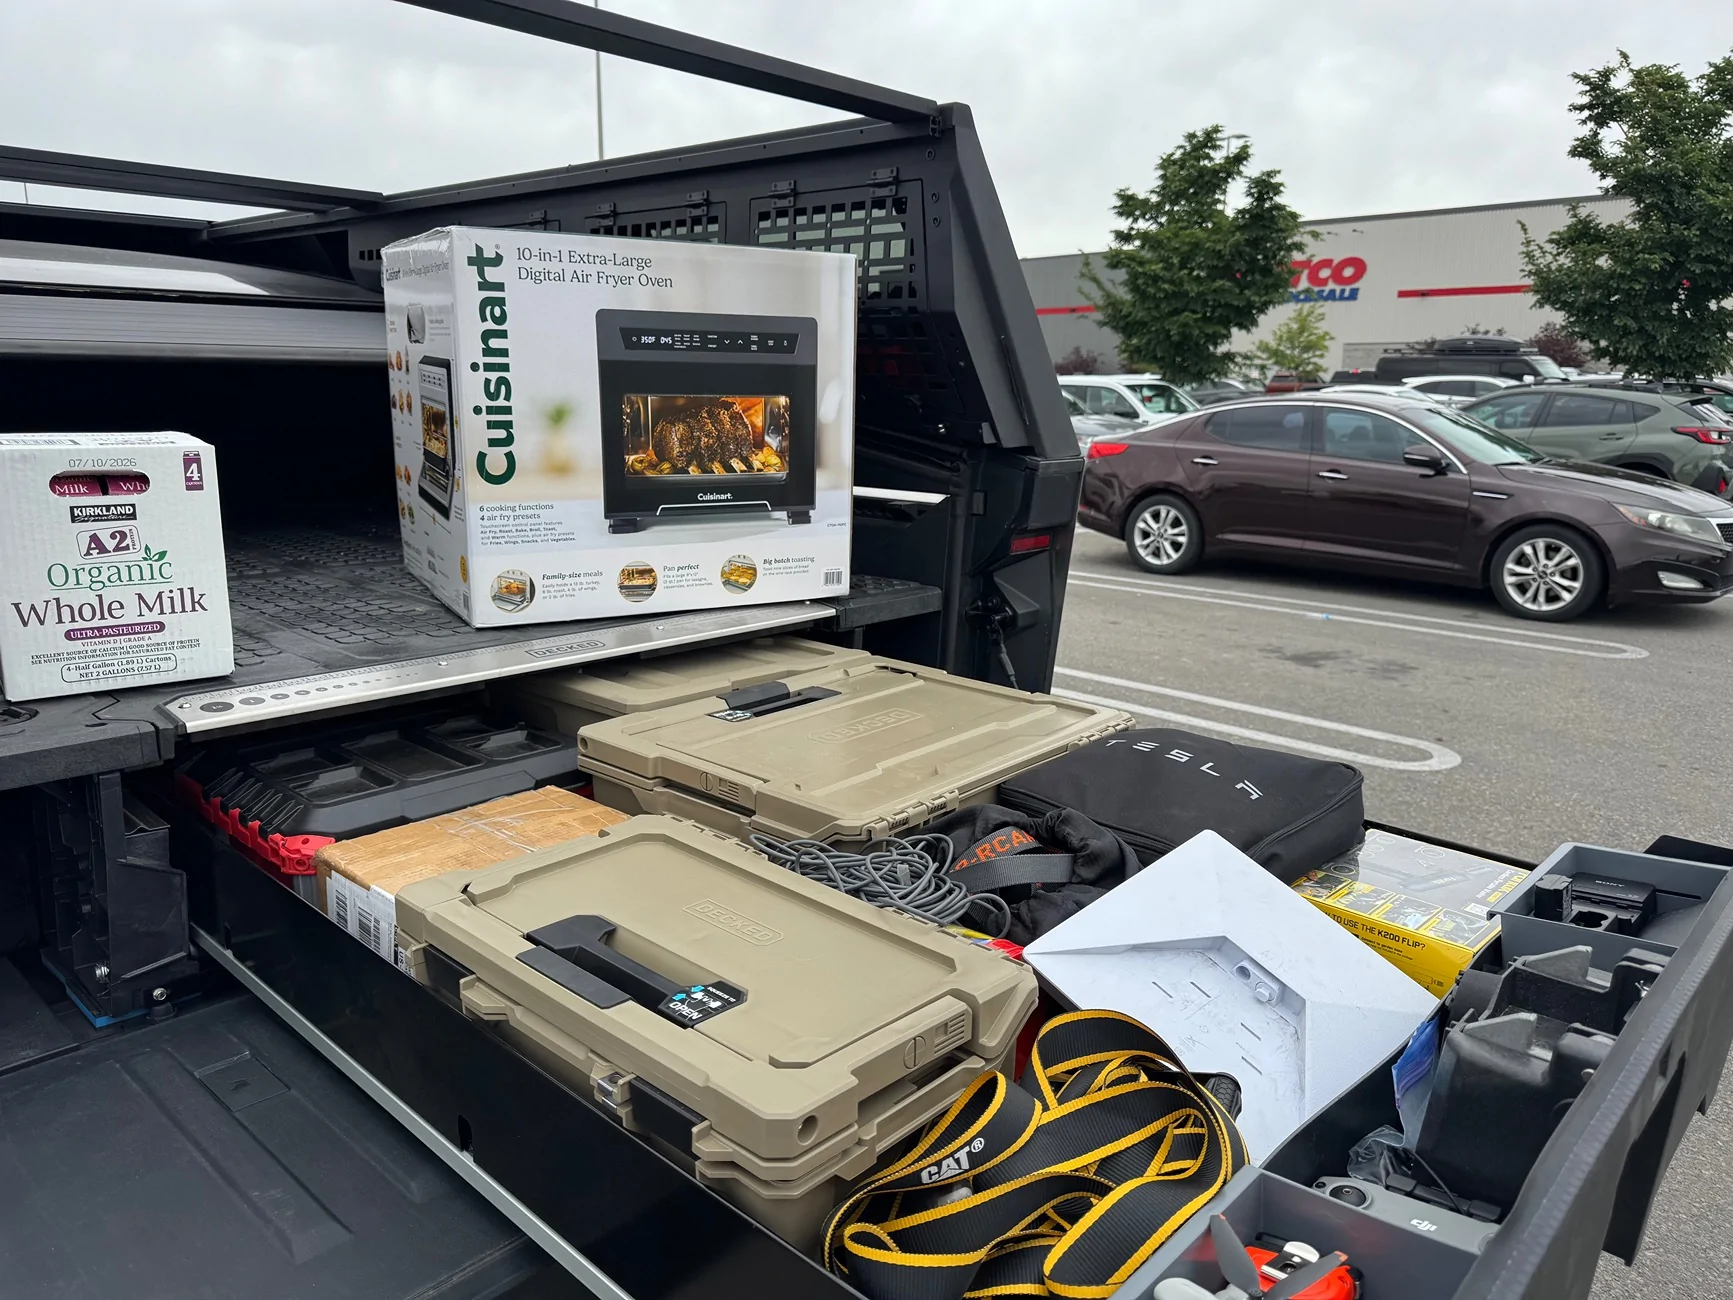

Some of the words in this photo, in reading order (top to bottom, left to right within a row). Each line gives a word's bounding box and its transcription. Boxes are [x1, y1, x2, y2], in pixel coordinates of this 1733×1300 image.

[517, 247, 562, 262] 10-in-1
[568, 250, 652, 270] Extra-Large
[518, 267, 565, 284] Digital
[570, 270, 592, 284] Air
[596, 271, 635, 288] Fryer
[638, 273, 673, 287] Oven
[1288, 256, 1367, 289] TCO
[68, 458, 137, 468] 07/10/2026
[186, 463, 200, 481] 4
[54, 484, 89, 494] Milk
[73, 505, 134, 517] KIRKLAND
[486, 504, 517, 513] cooking
[518, 503, 554, 511] functions
[500, 513, 511, 521] fry
[513, 512, 541, 521] presets
[83, 530, 130, 556] A2
[47, 560, 173, 591] Organic
[542, 571, 581, 580] Family-size
[677, 564, 699, 572] perfect
[11, 594, 125, 628] Whole
[134, 586, 208, 617] Milk
[70, 623, 160, 639] ULTRA-PASTEURIZED
[31, 652, 65, 660] EXCELLENT
[78, 652, 118, 660] INFORMATION
[534, 641, 599, 656] DECKED
[66, 664, 90, 672] 4-Half
[92, 661, 115, 669] Gallon
[79, 671, 94, 679] NET
[101, 667, 136, 676] GALLONS
[137, 665, 152, 673] (7.57
[820, 711, 912, 740] DECKED
[1105, 739, 1264, 800] TESLA
[694, 904, 773, 942] DECKED
[1343, 918, 1359, 930] USE
[1361, 923, 1377, 934] THE
[1377, 929, 1400, 942] K200
[1401, 937, 1426, 950] FLIP?
[669, 1001, 702, 1020] OPEN
[1410, 1218, 1438, 1231] dji
